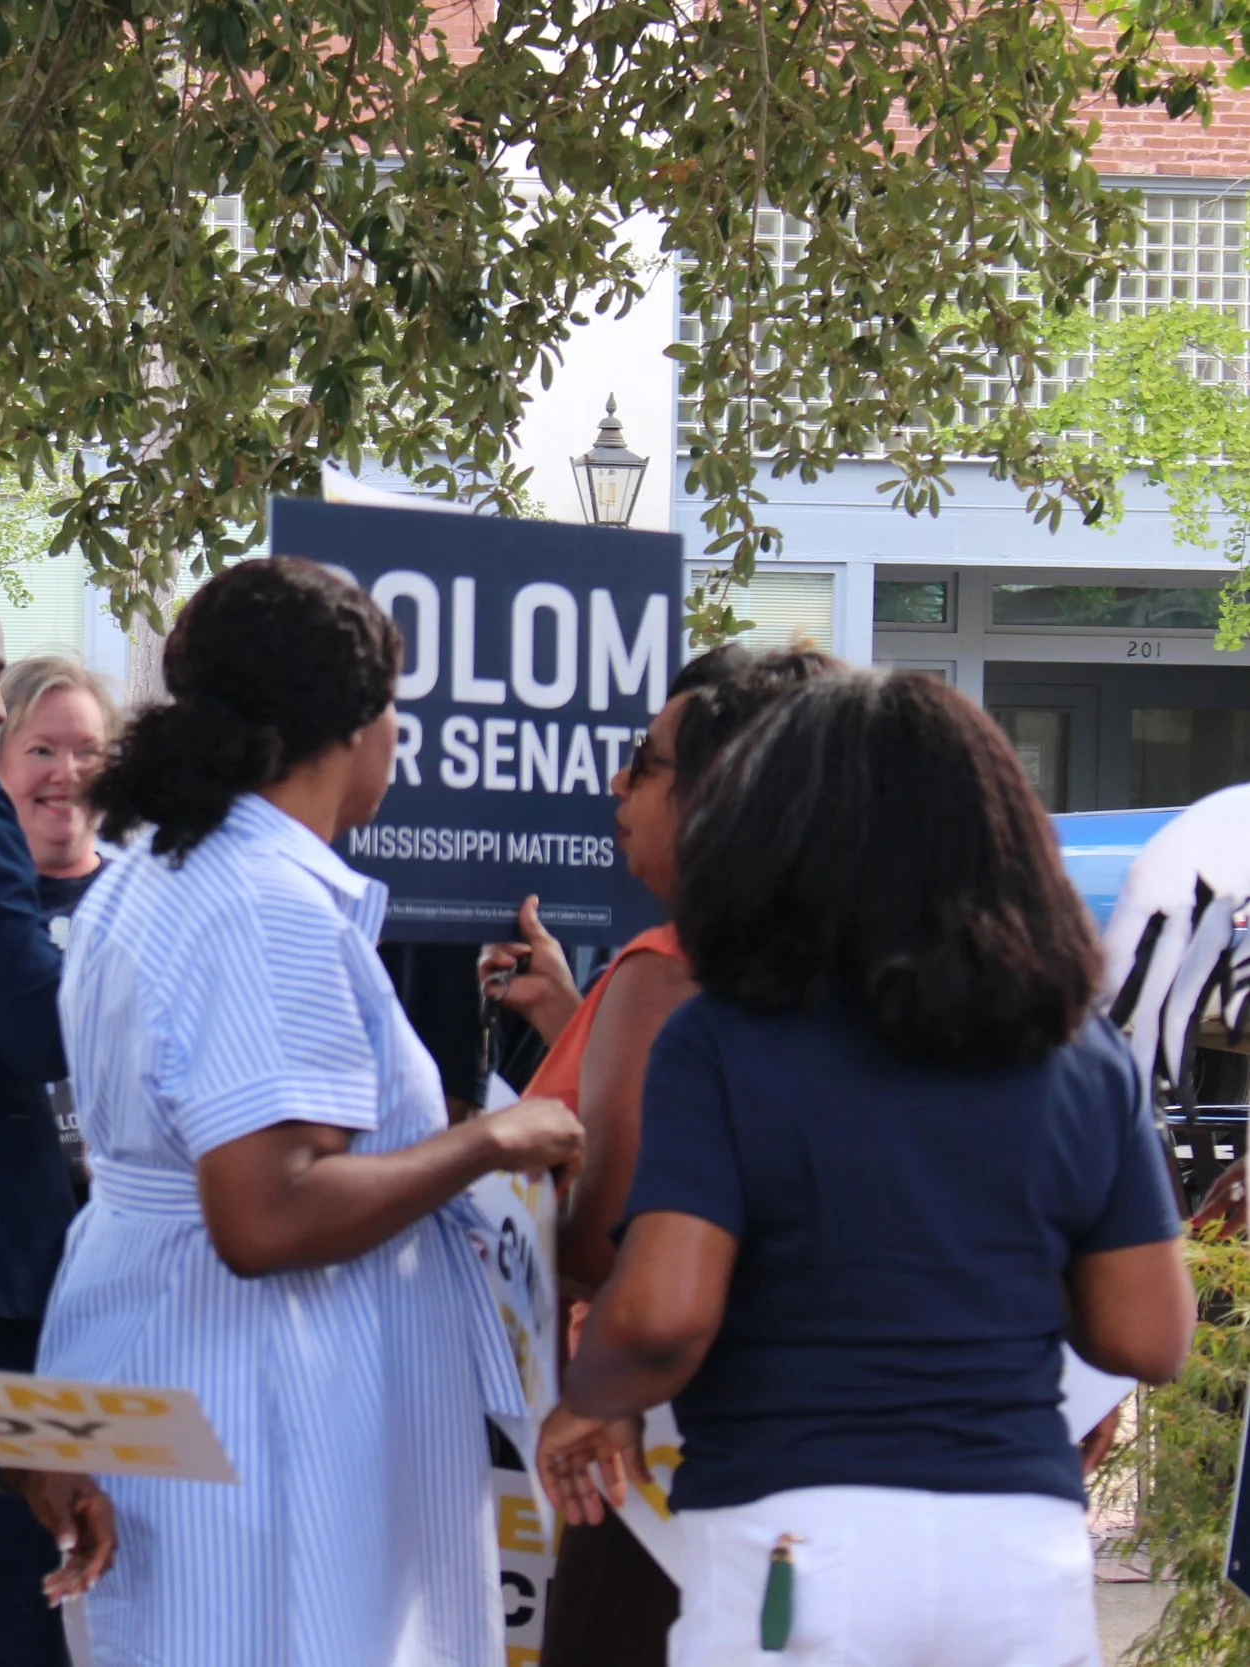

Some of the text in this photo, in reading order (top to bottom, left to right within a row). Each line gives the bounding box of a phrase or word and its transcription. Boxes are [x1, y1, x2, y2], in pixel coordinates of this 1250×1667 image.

[322, 563, 670, 713] OLOM
[1126, 641, 1161, 658] 201
[440, 715, 647, 796] SENAT
[350, 825, 614, 867] MISSISSIPPI MATTERS
